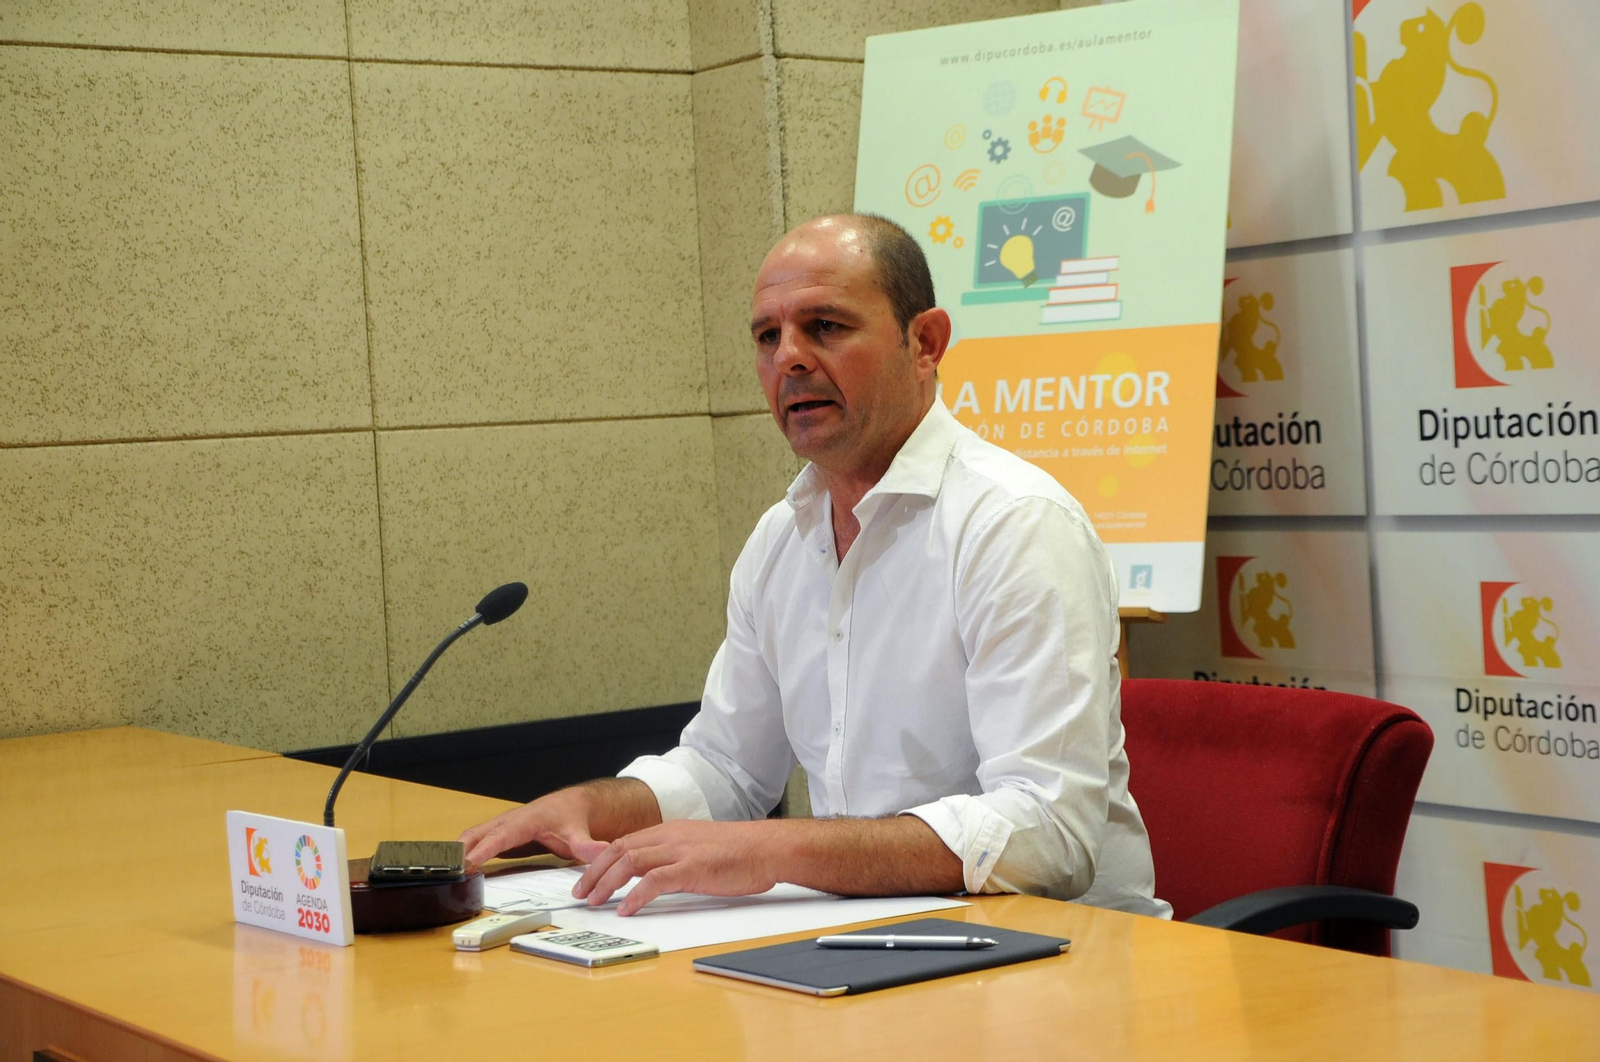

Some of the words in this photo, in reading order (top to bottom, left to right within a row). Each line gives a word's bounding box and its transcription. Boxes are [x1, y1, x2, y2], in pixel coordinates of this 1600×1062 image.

[940, 30, 1152, 65] www.dipucordoba.es/aulamentor
[994, 371, 1171, 414] MENTOR
[1020, 422, 1046, 439] DE
[1061, 416, 1169, 437] CÓRDOBA
[1214, 411, 1322, 448] utación
[1418, 401, 1599, 448] Diputación
[1210, 457, 1326, 491] Córdoba
[1419, 454, 1456, 486] de
[1467, 450, 1600, 485] Córdoba
[1455, 687, 1598, 724] Diputación
[1456, 724, 1486, 750] de
[1495, 726, 1600, 759] Córdoba
[241, 880, 283, 902] Diputación
[296, 893, 328, 911] AGENDA
[242, 898, 252, 912] de
[254, 901, 285, 920] Córdoba
[297, 907, 330, 934] 2030
